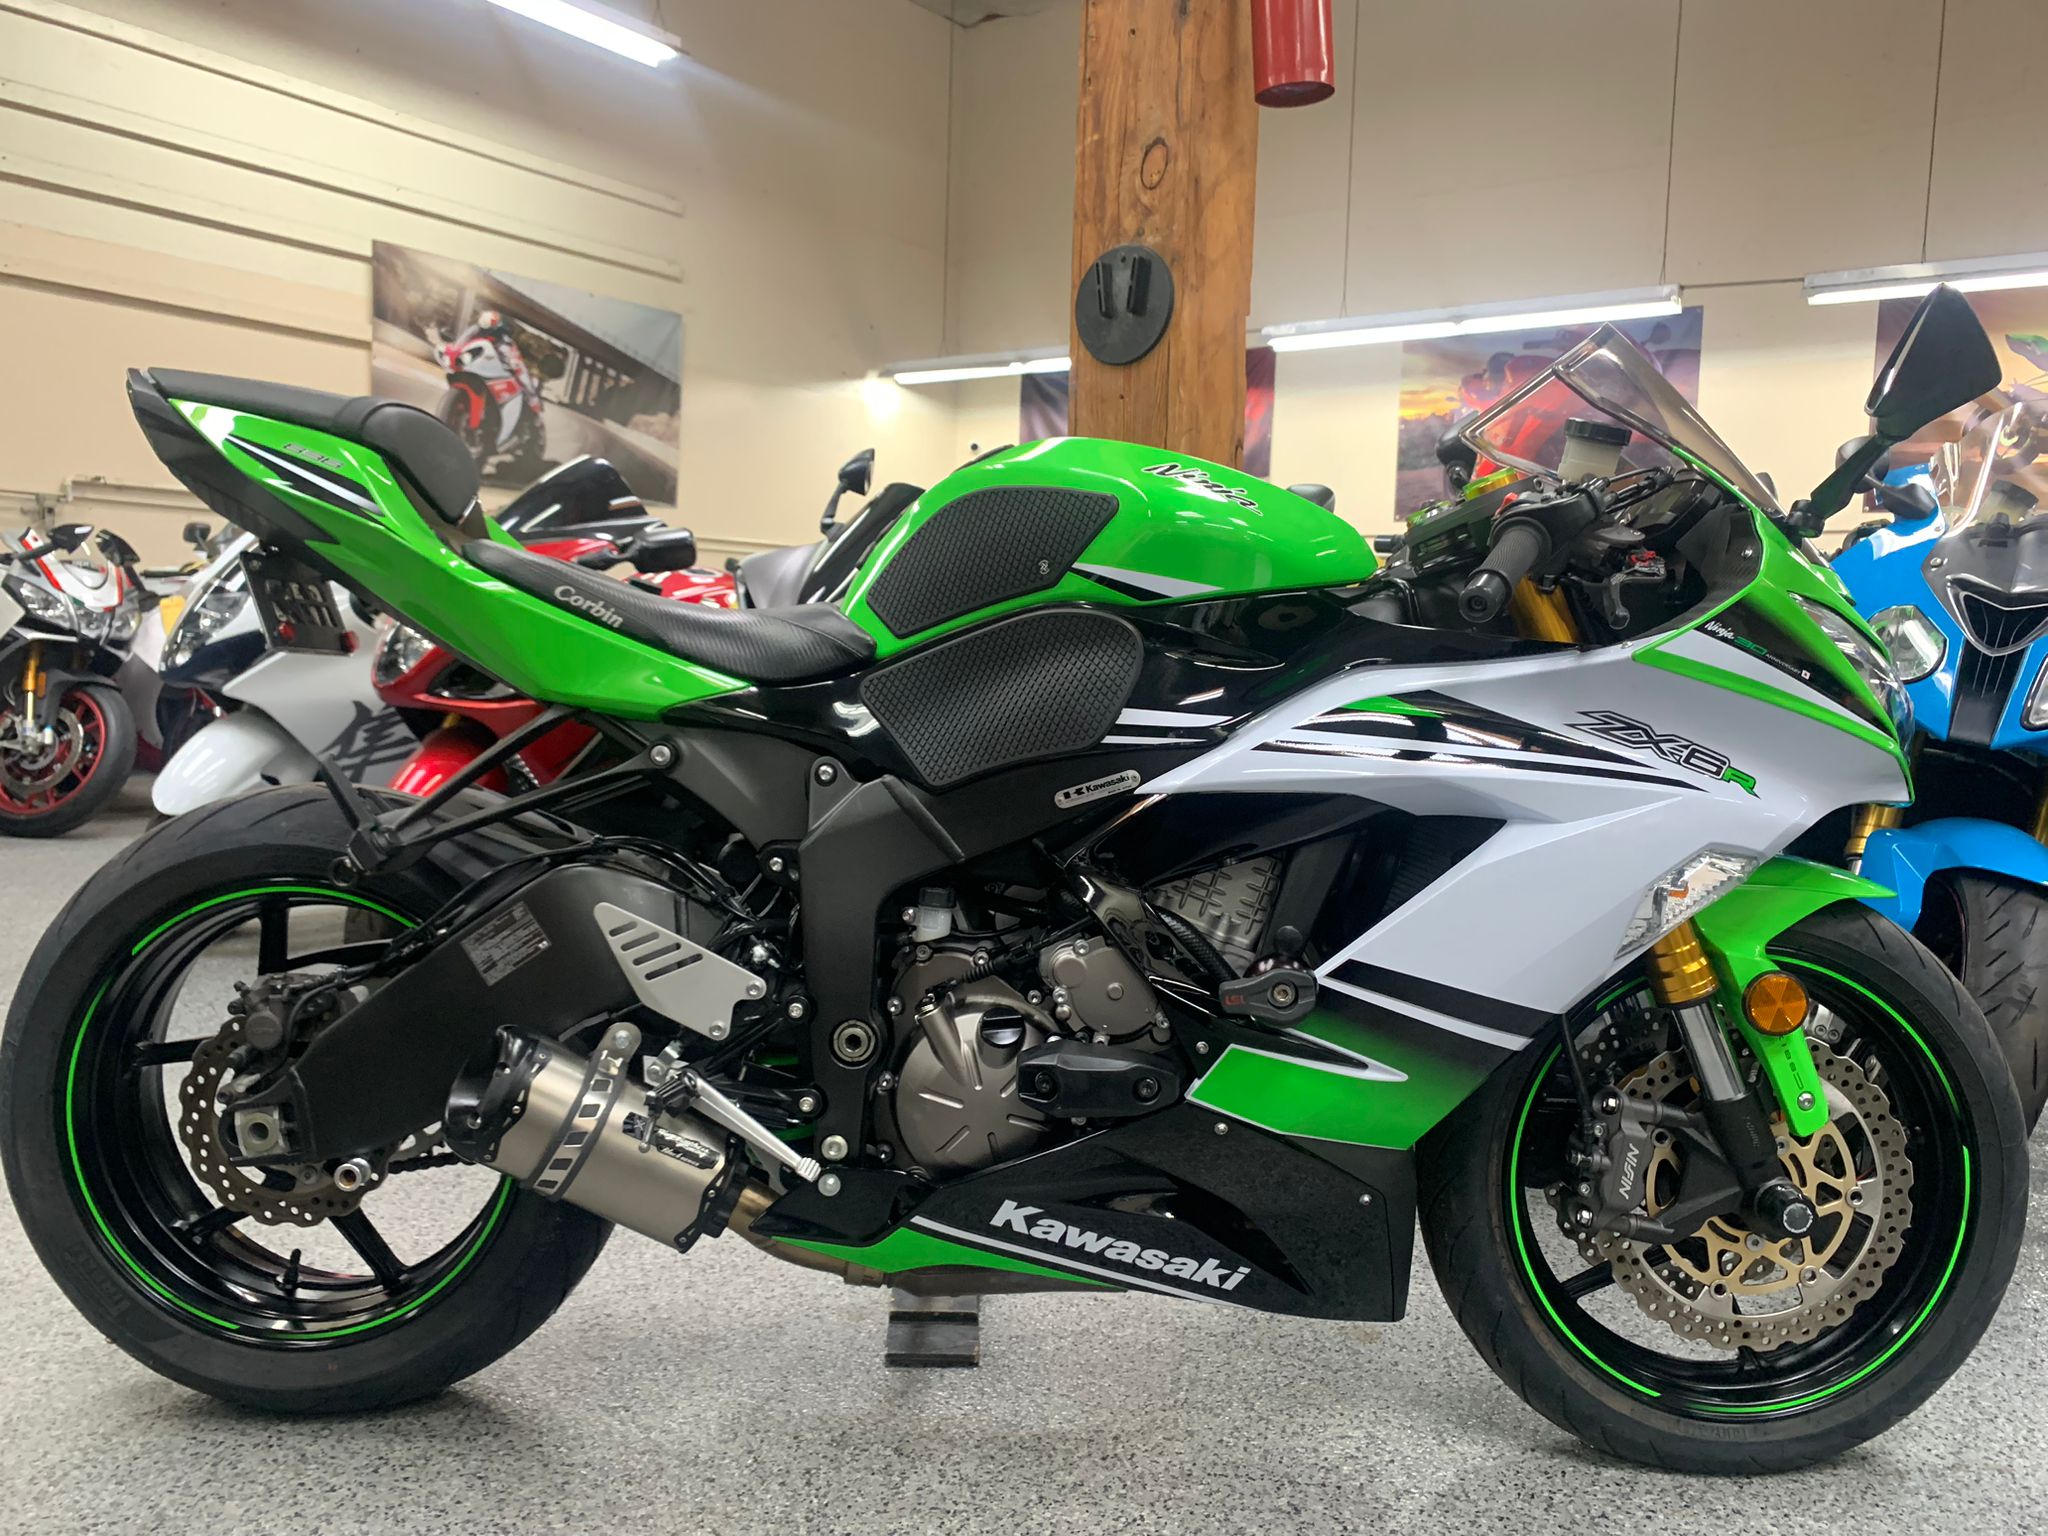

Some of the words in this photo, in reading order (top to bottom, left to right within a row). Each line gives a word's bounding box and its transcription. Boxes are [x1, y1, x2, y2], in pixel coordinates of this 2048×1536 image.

[1141, 462, 1264, 517] Ninja
[554, 585, 623, 628] Corbin
[1704, 620, 1735, 640] Ninja
[1085, 773, 1130, 793] Kawasaki
[989, 1199, 1251, 1291] Kawasaki
